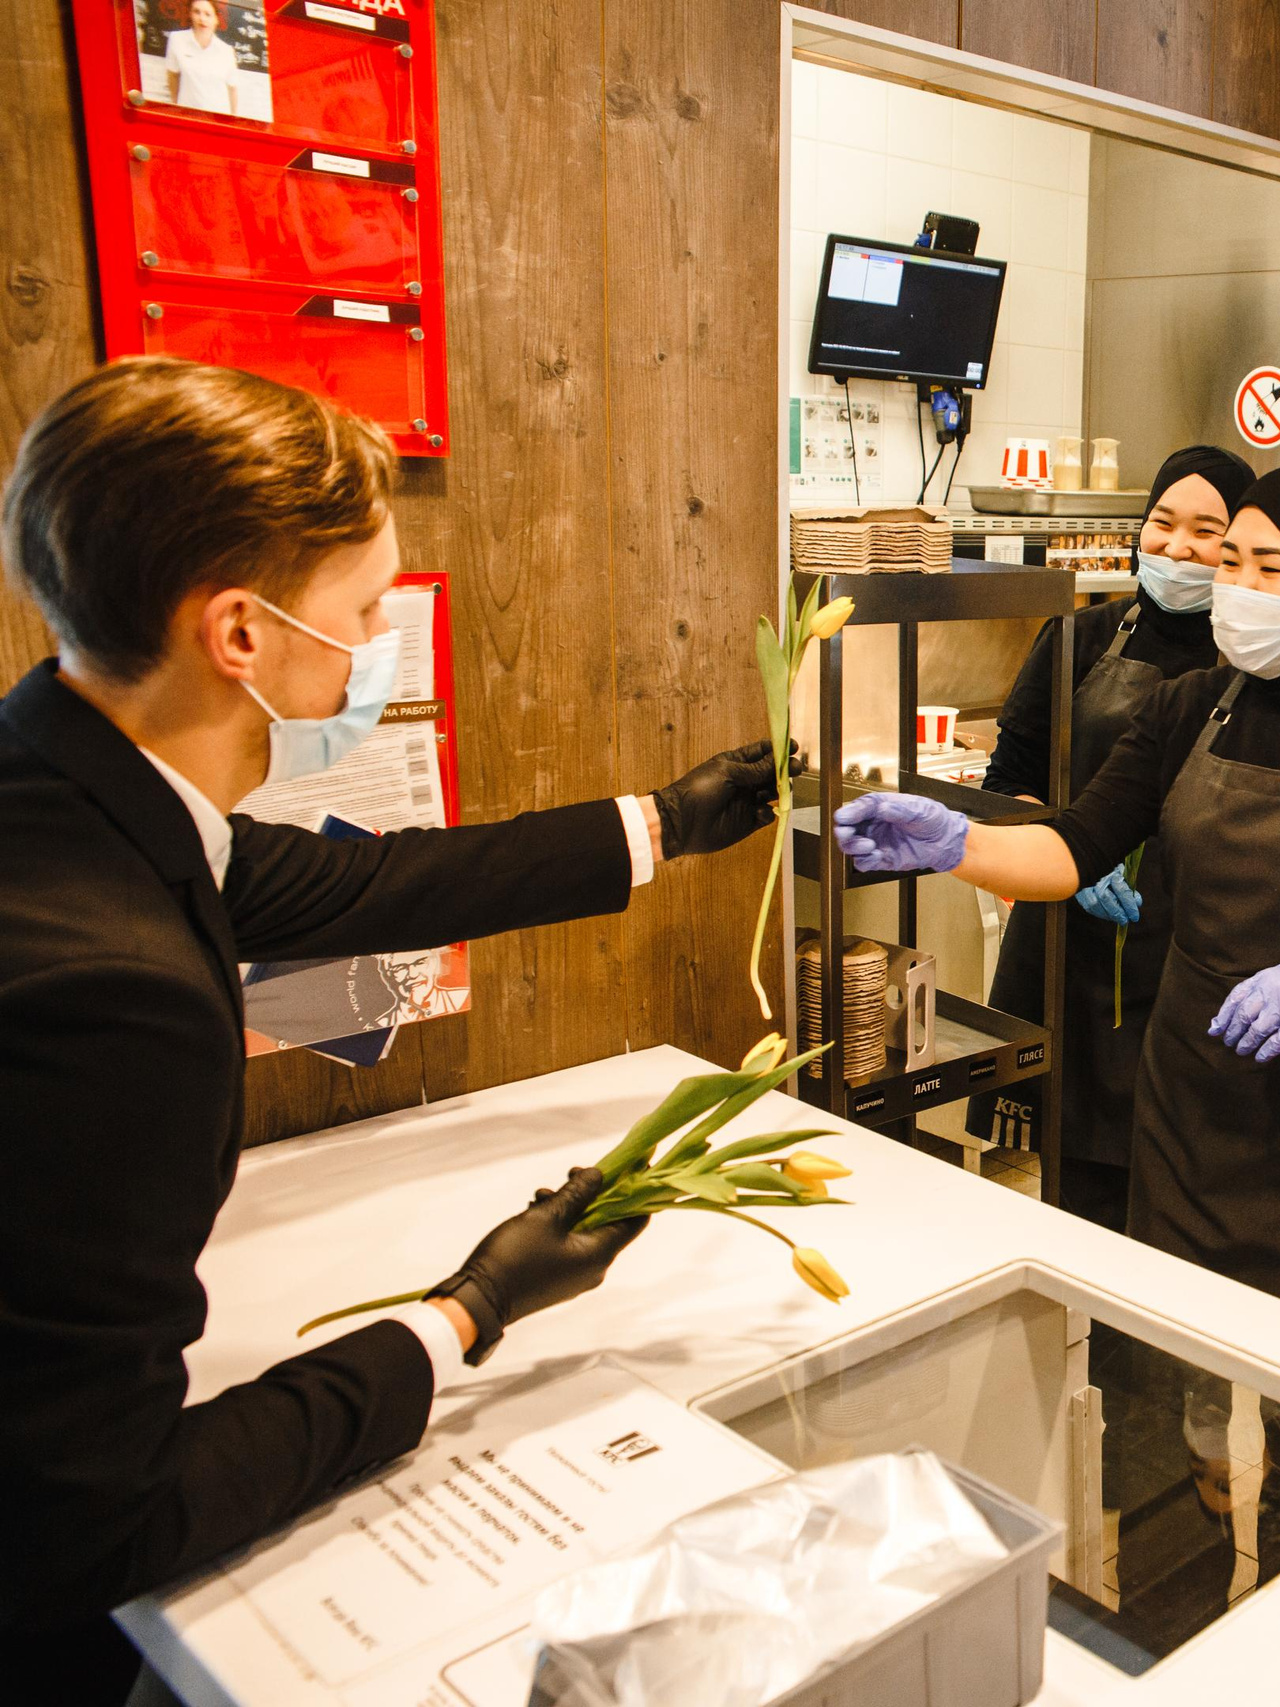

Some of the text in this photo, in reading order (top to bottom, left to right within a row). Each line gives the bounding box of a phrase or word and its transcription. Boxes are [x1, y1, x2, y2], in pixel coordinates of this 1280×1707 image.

[383, 705, 438, 717] НА РАБОТУ
[346, 980, 360, 1014] world
[1019, 1048, 1044, 1064] ГЛЯСЕ
[970, 1064, 996, 1076] АМЕРИКАНО
[914, 1078, 940, 1095] ЛАТТЕ
[855, 1097, 885, 1112] КАПУЧИНО
[994, 1096, 1033, 1120] KFC
